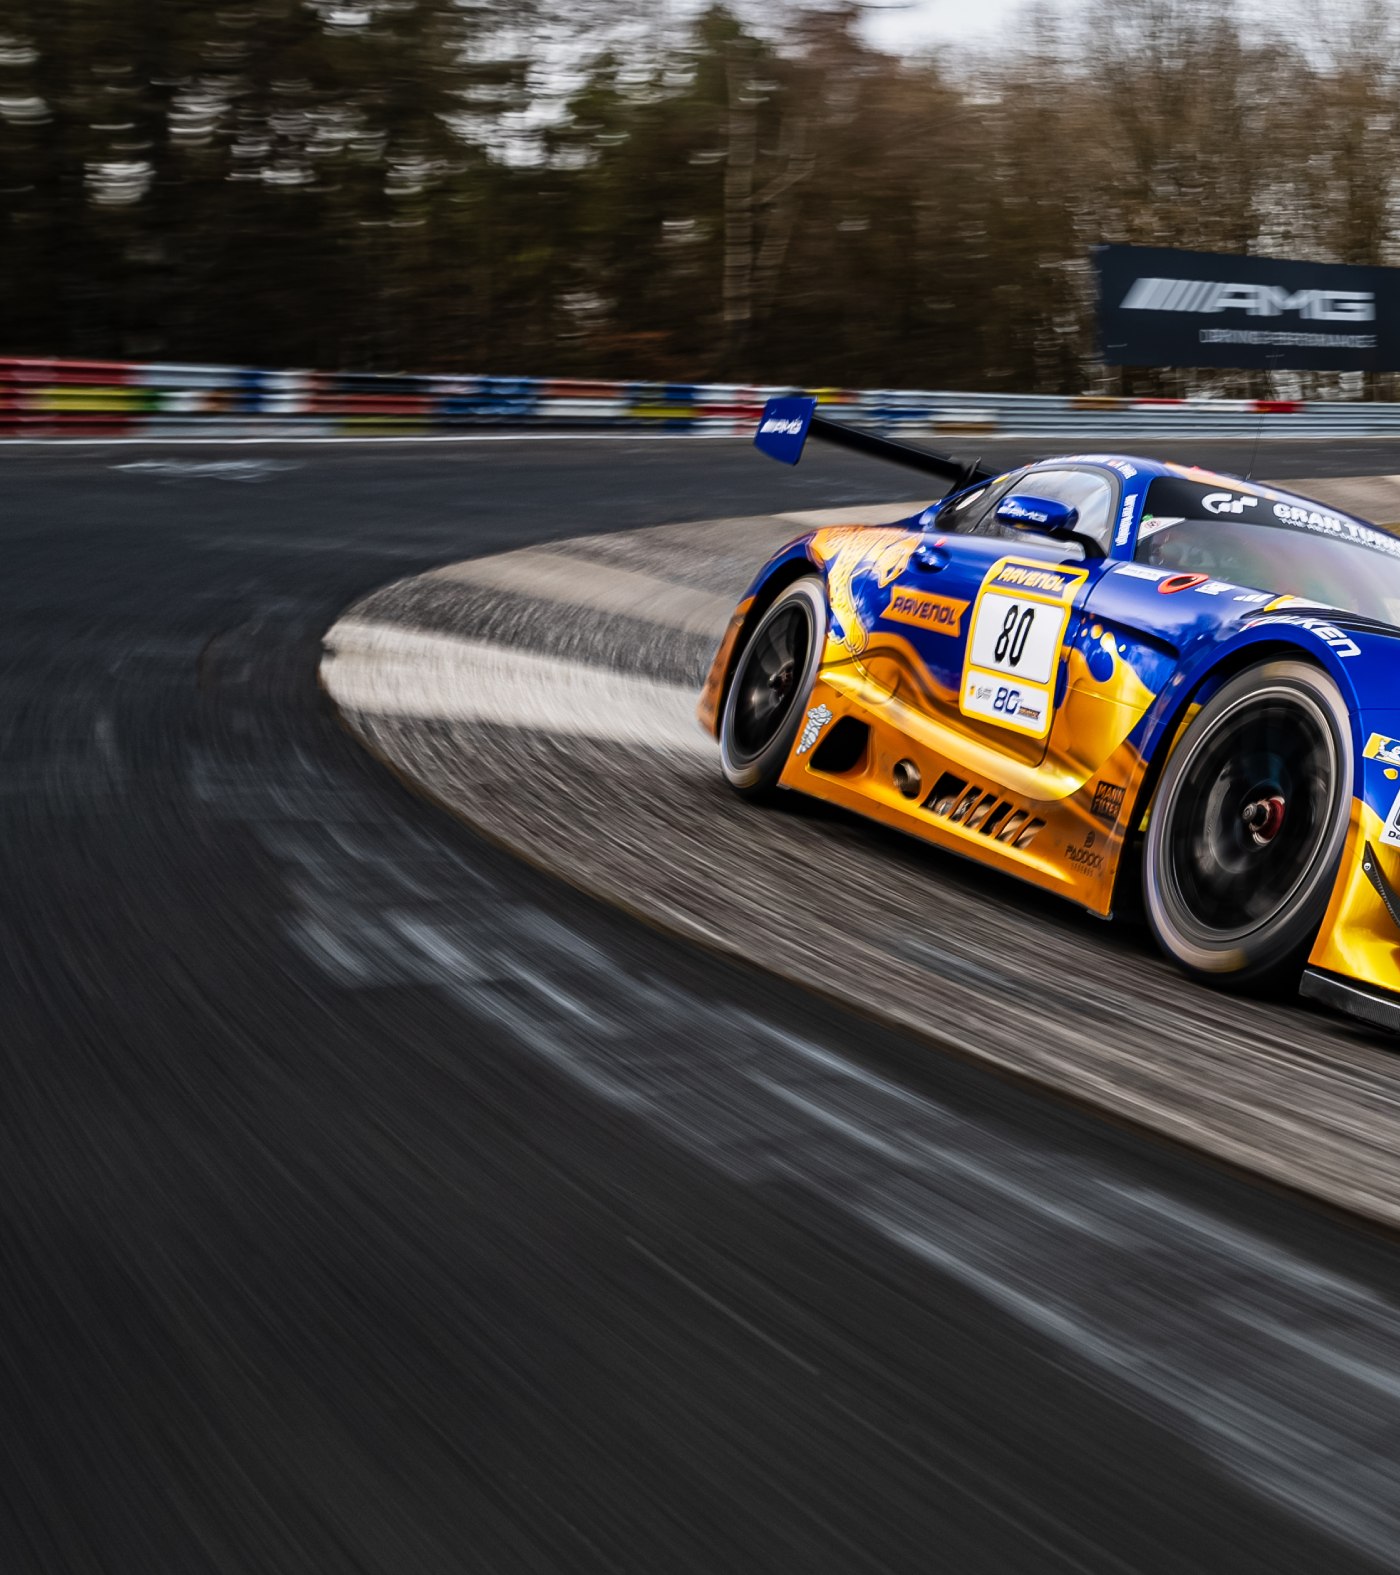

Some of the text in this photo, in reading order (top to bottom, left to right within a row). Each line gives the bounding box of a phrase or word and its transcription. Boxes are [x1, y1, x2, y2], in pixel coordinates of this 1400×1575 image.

[1205, 283, 1377, 321] AMG
[1273, 503, 1342, 532] GRAN
[998, 566, 1066, 592] RAVENOL
[892, 595, 957, 626] RAVENOL
[993, 604, 1035, 667] 80
